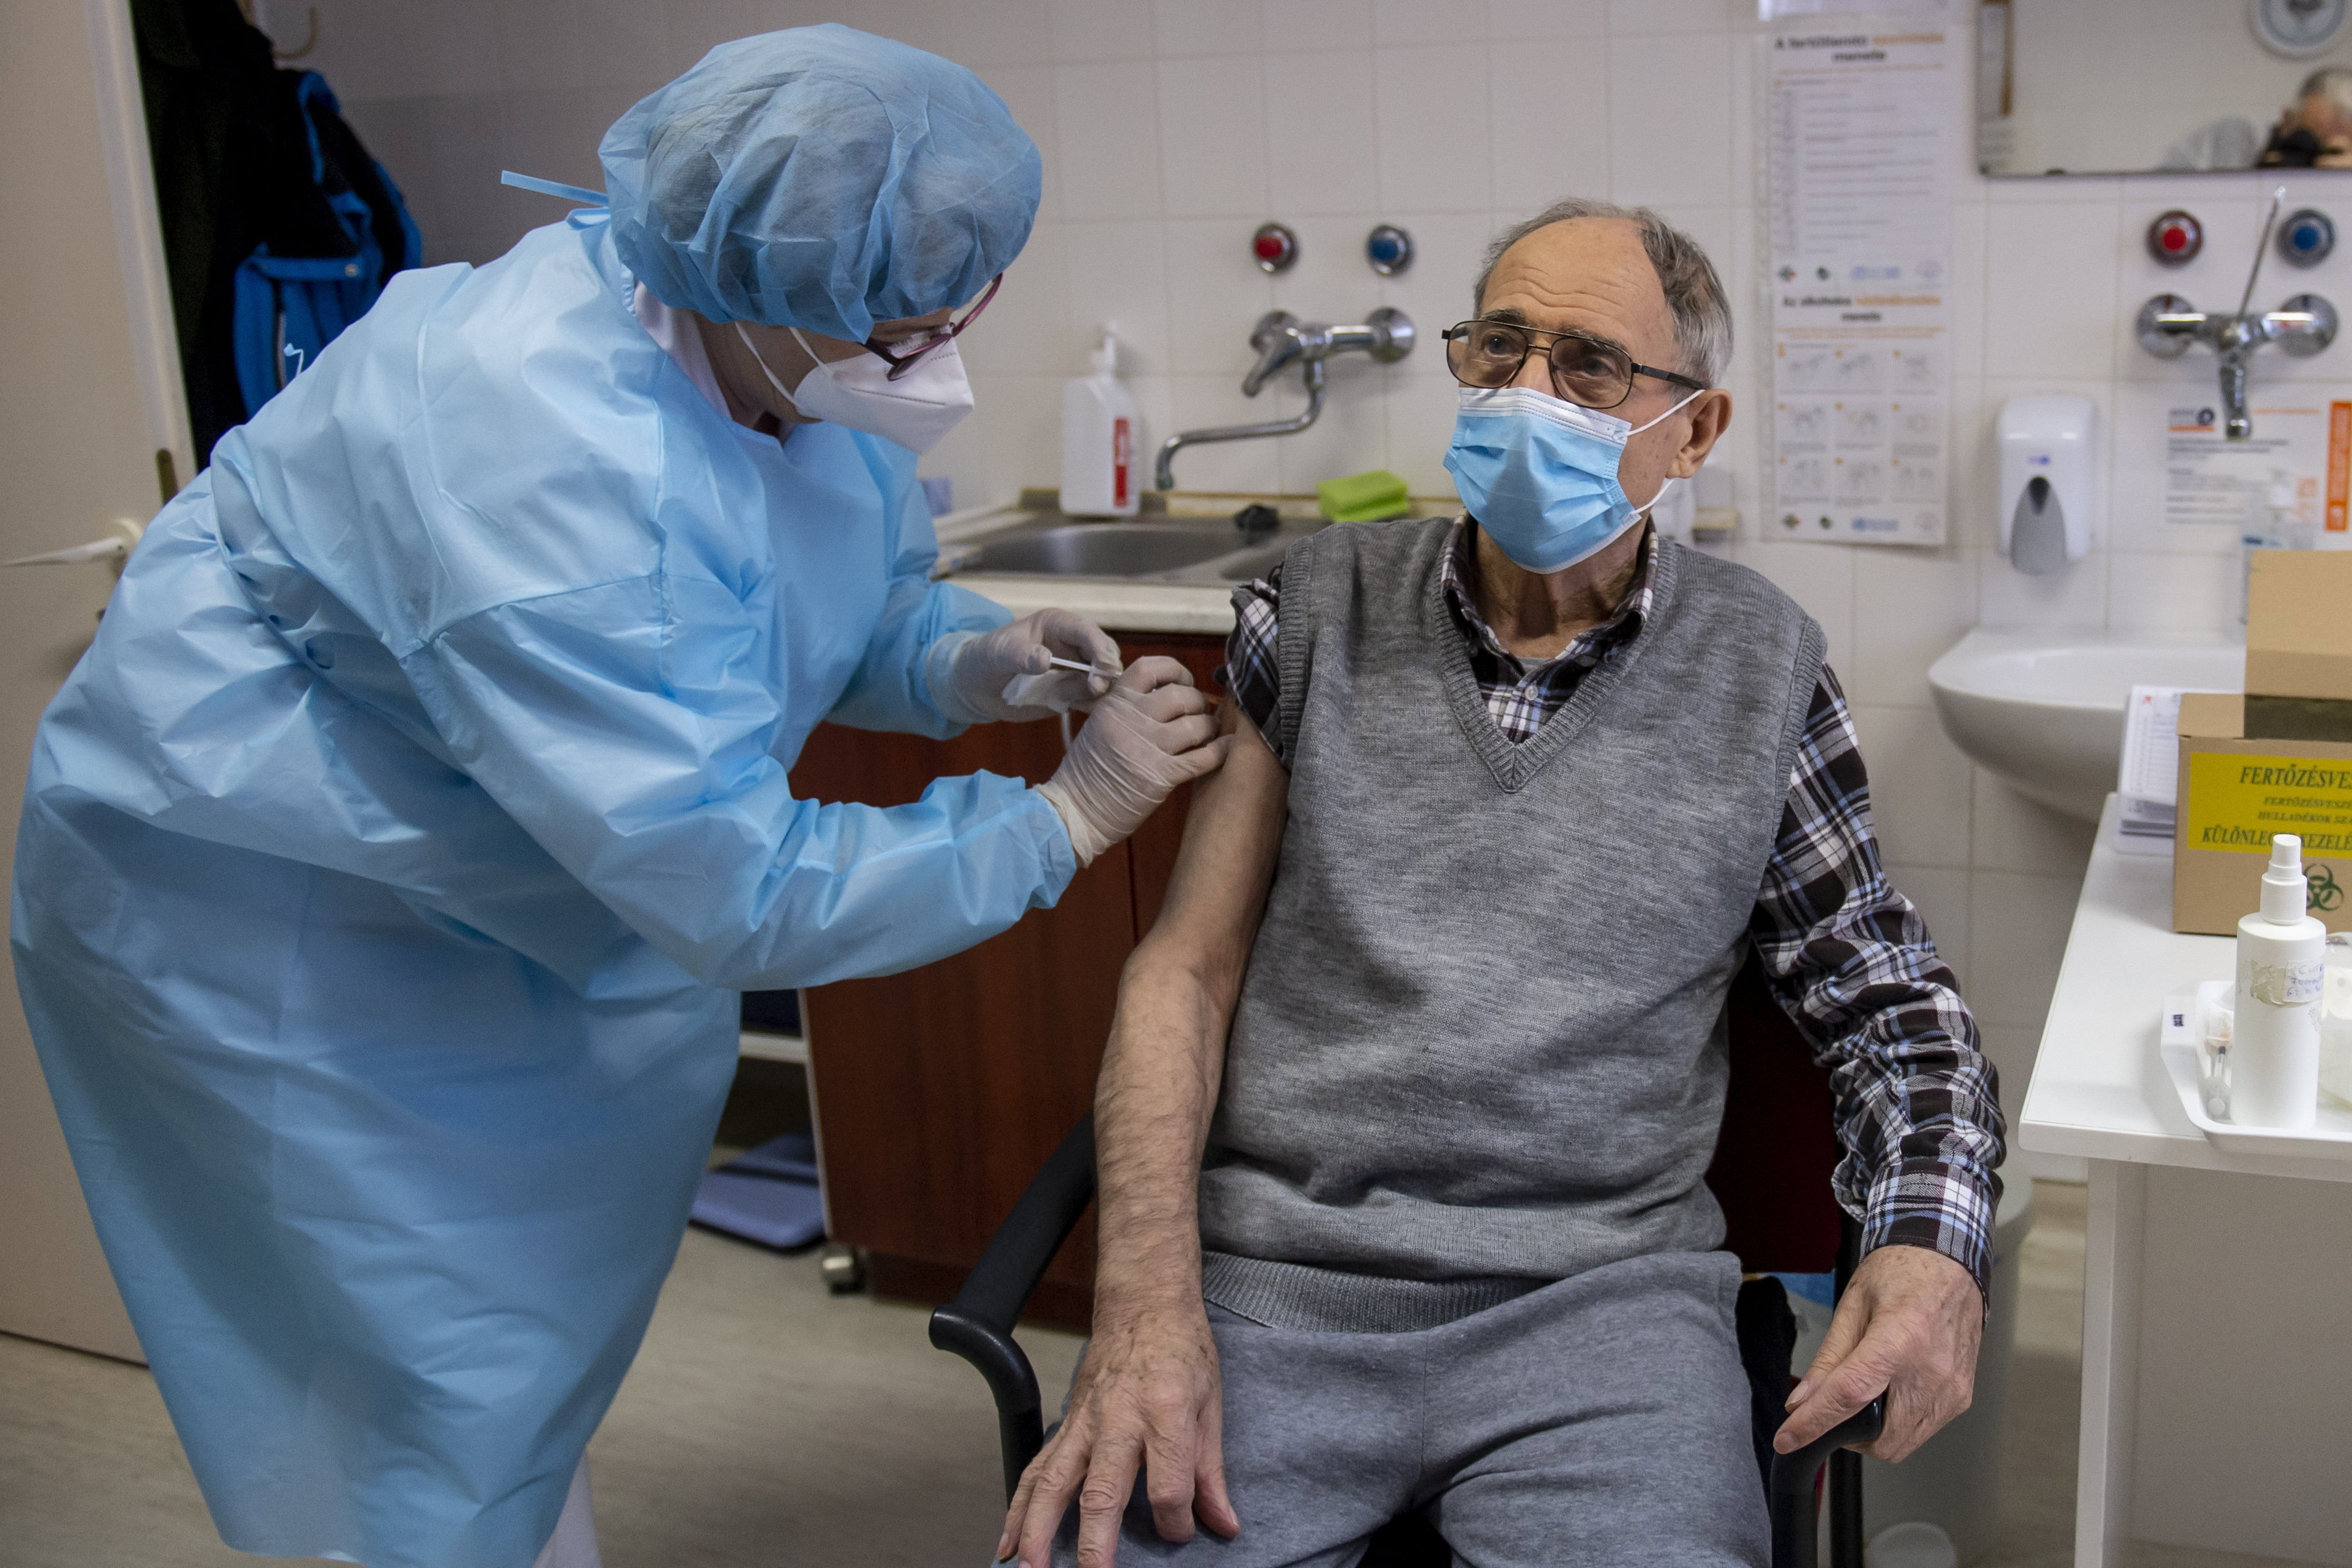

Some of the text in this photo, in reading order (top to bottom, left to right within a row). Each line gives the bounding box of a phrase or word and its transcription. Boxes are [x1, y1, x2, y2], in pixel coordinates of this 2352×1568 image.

[2240, 763, 2352, 790] FERTŐZÉSVE
[2334, 815, 2352, 825] SZ
[2202, 824, 2296, 846] KÜLÖNLE
